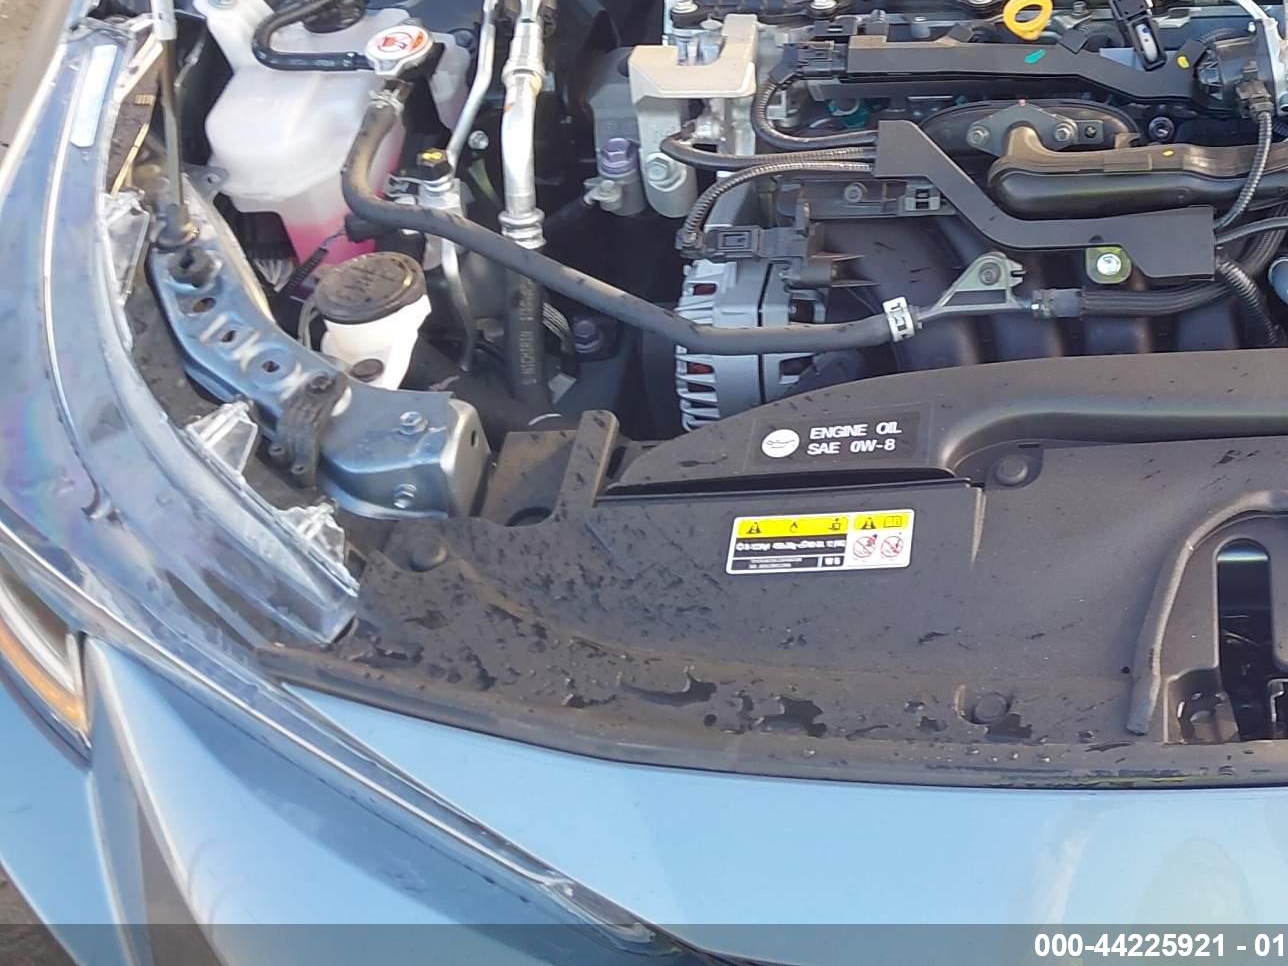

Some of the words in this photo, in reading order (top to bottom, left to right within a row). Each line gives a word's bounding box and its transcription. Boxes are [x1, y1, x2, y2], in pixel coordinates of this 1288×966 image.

[809, 424, 868, 440] ENGINE
[876, 421, 903, 435] OIL
[807, 441, 842, 455] SAE
[850, 438, 896, 453] 0W-8
